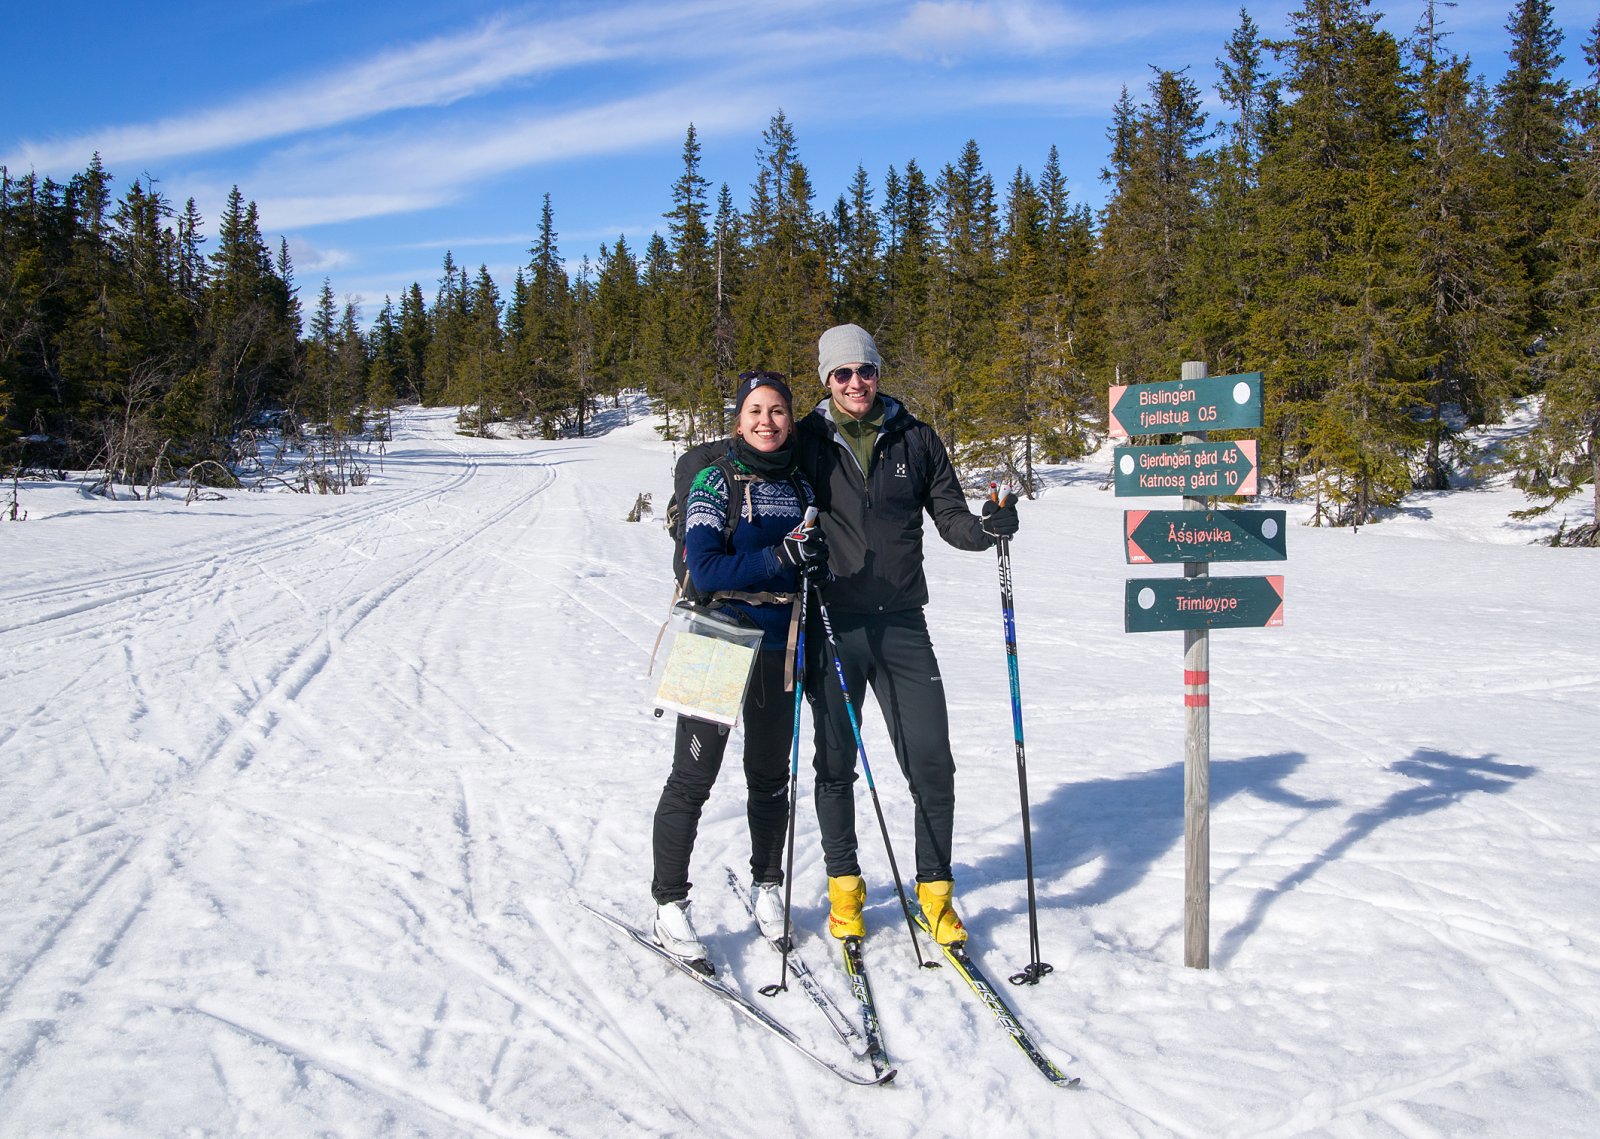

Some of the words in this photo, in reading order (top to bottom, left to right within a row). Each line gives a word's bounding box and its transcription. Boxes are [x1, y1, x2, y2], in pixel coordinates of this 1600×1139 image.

[1139, 389, 1196, 406] Bislingen
[1140, 409, 1189, 428] fjellstua
[1139, 452, 1191, 470] Gjerdingen
[1194, 450, 1218, 468] gård
[1139, 473, 1186, 488] Katnosa
[1190, 471, 1218, 489] gård
[1224, 470, 1238, 486] 10
[1167, 522, 1232, 544] Åssjøvika
[1175, 596, 1238, 613] Trimløype
[972, 980, 1023, 1039] FISCHER
